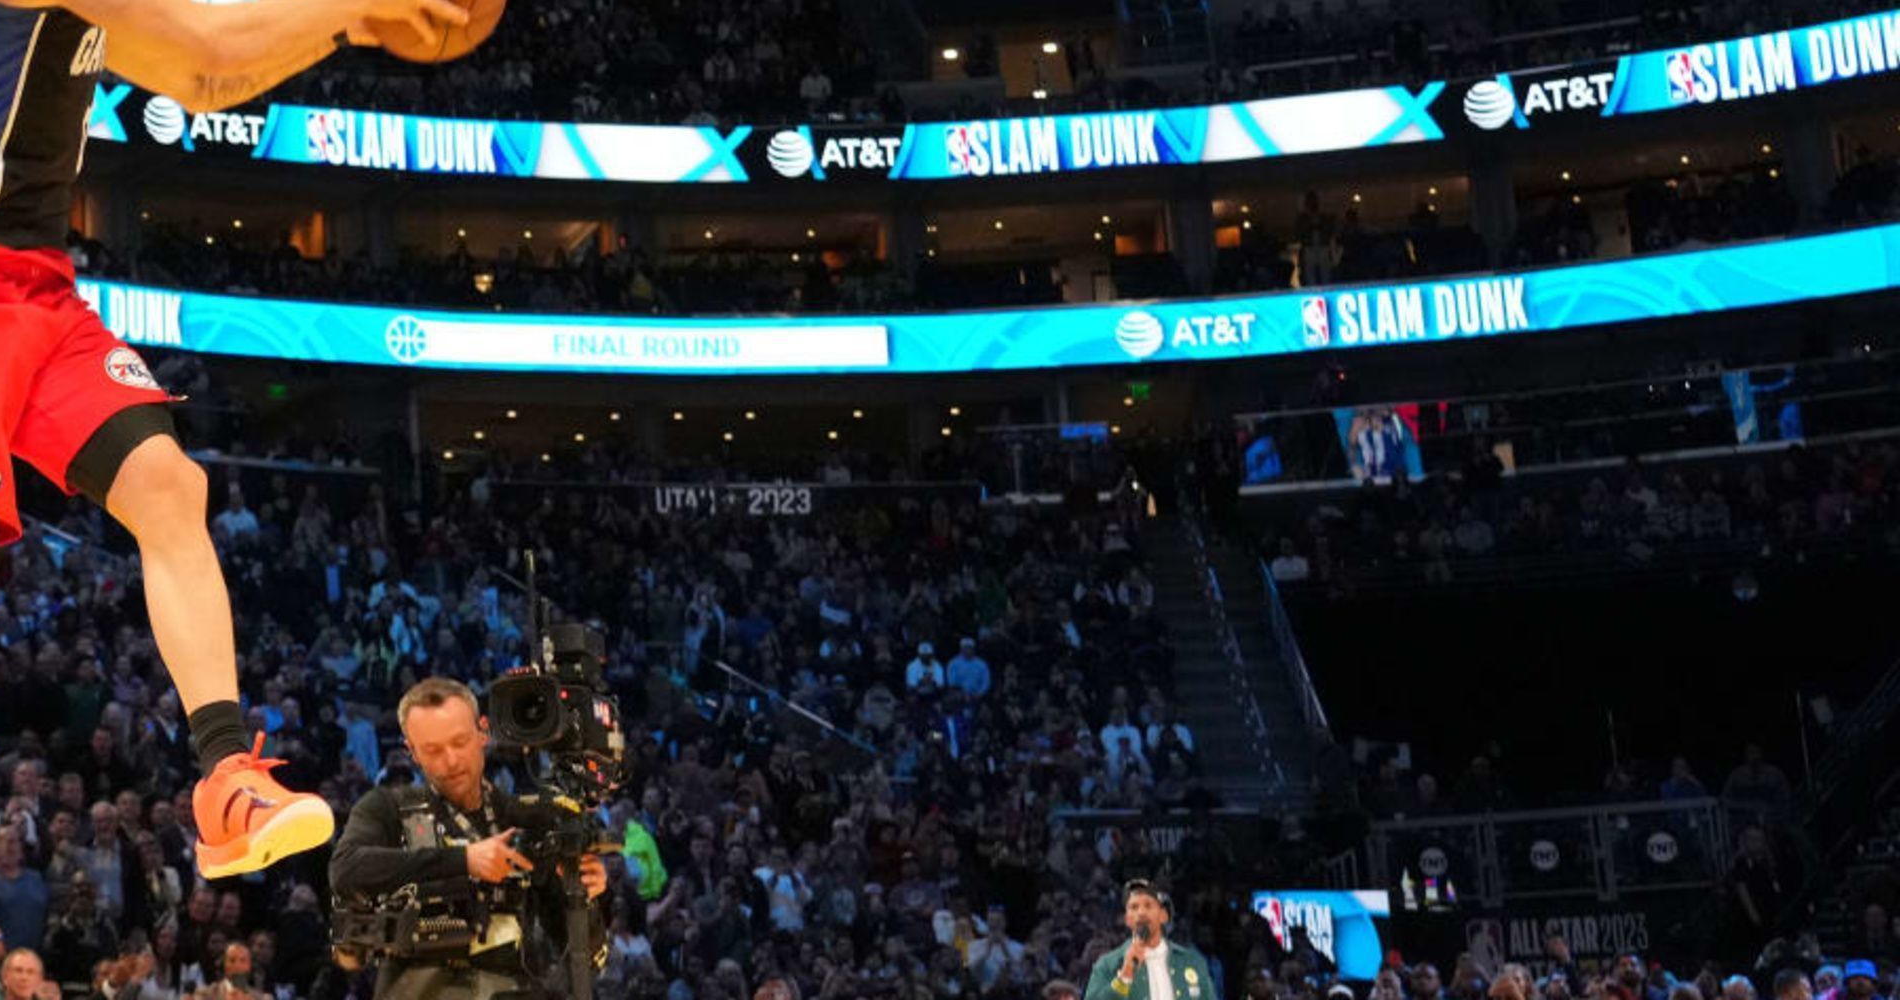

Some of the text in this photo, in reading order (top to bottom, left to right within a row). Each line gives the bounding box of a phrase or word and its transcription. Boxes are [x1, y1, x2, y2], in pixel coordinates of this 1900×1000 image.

[1689, 9, 1900, 104] SLAM DUNK
[1522, 72, 1616, 116] AT&T
[189, 111, 265, 146] AT&T
[326, 110, 497, 173] SLAM DUNK
[967, 113, 1160, 177] SLAM DUNK
[820, 138, 901, 168] AT&T
[108, 286, 183, 345] DUNK
[1171, 313, 1257, 349] AT&T
[1339, 278, 1529, 344] SLAM DUNK
[553, 333, 741, 358] FINAL ROUND
[1601, 912, 1649, 951] 2023
